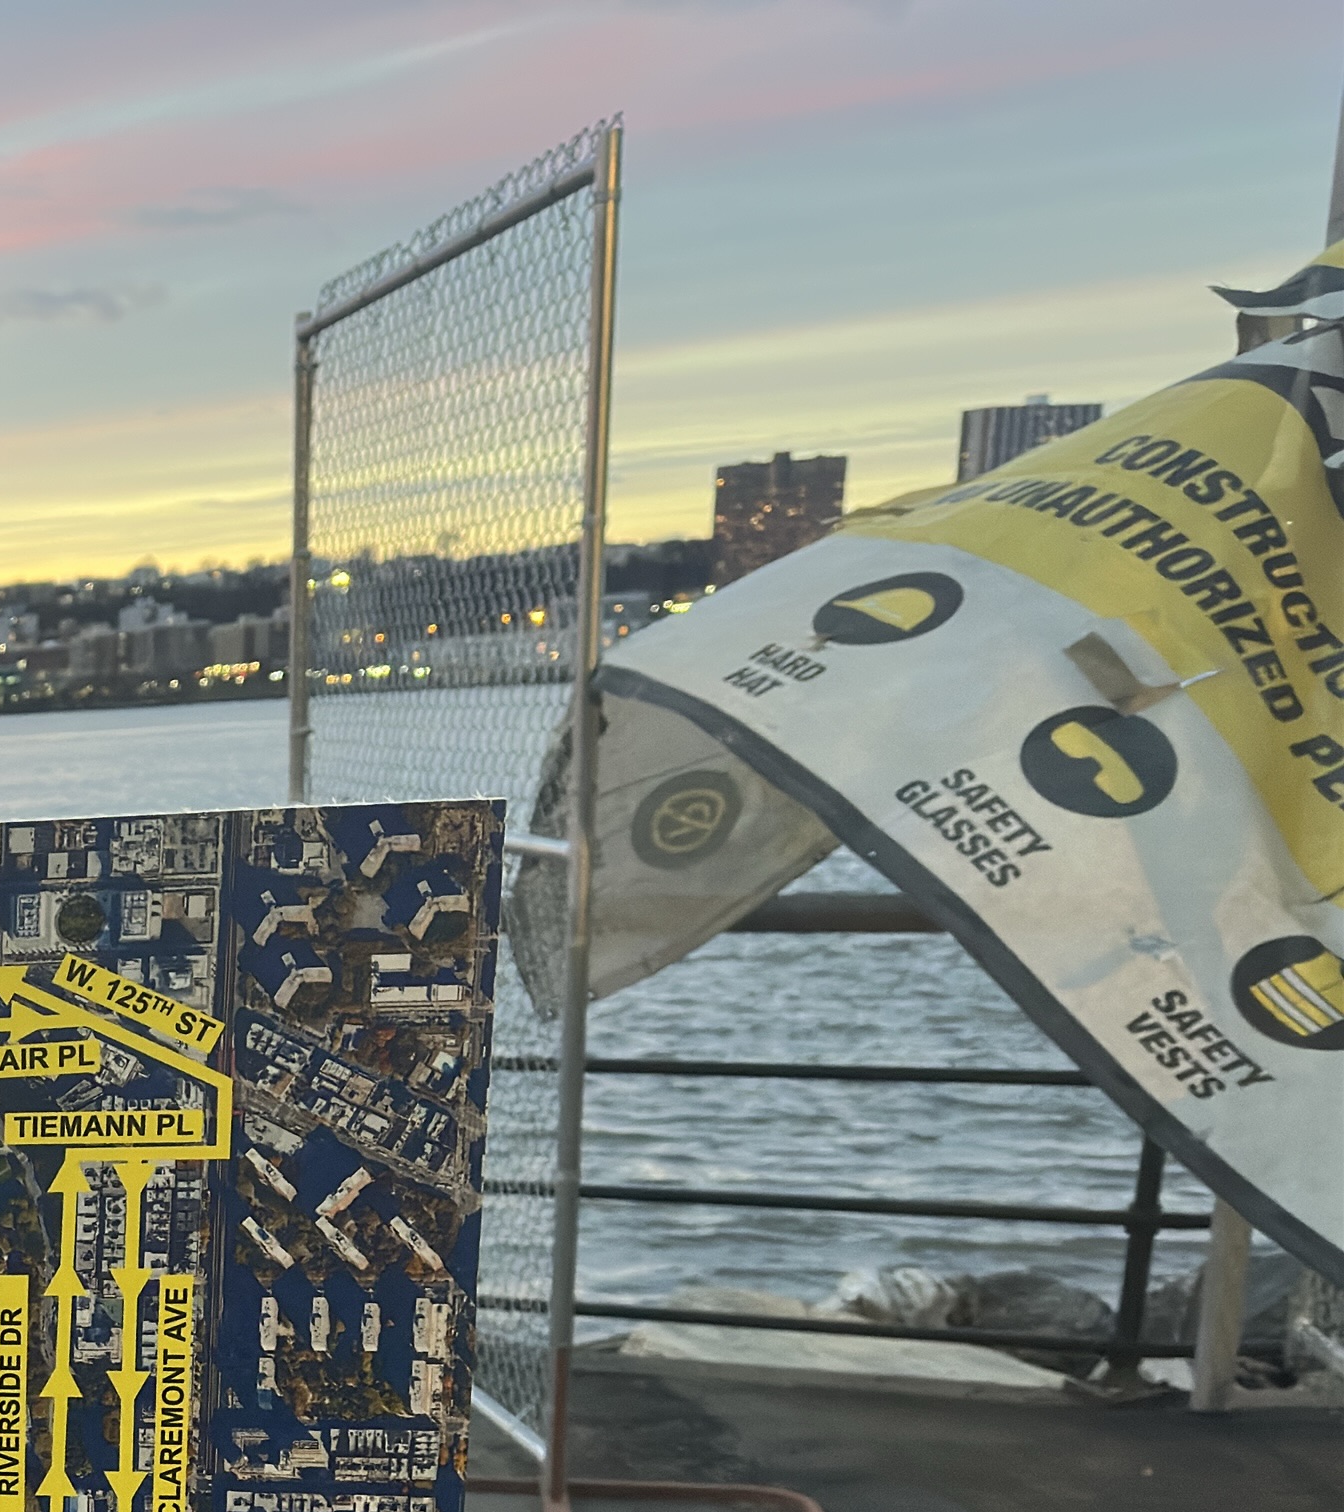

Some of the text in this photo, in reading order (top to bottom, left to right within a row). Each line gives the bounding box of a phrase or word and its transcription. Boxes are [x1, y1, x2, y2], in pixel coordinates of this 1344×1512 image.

[985, 480, 1304, 723] UNAUTHORIZED
[722, 666, 784, 698] HAT
[748, 642, 827, 682] HARD
[895, 780, 1022, 888] GLASSES
[940, 768, 1053, 857] SAFETY
[65, 958, 217, 1042] W. 125TH ST
[58, 1044, 95, 1068] PL
[1126, 1011, 1226, 1099] VESTS
[1152, 989, 1275, 1087] SAFETY
[13, 1113, 194, 1138] TIEMANN PL
[0, 1307, 23, 1346] DR
[163, 1286, 188, 1342] AVE
